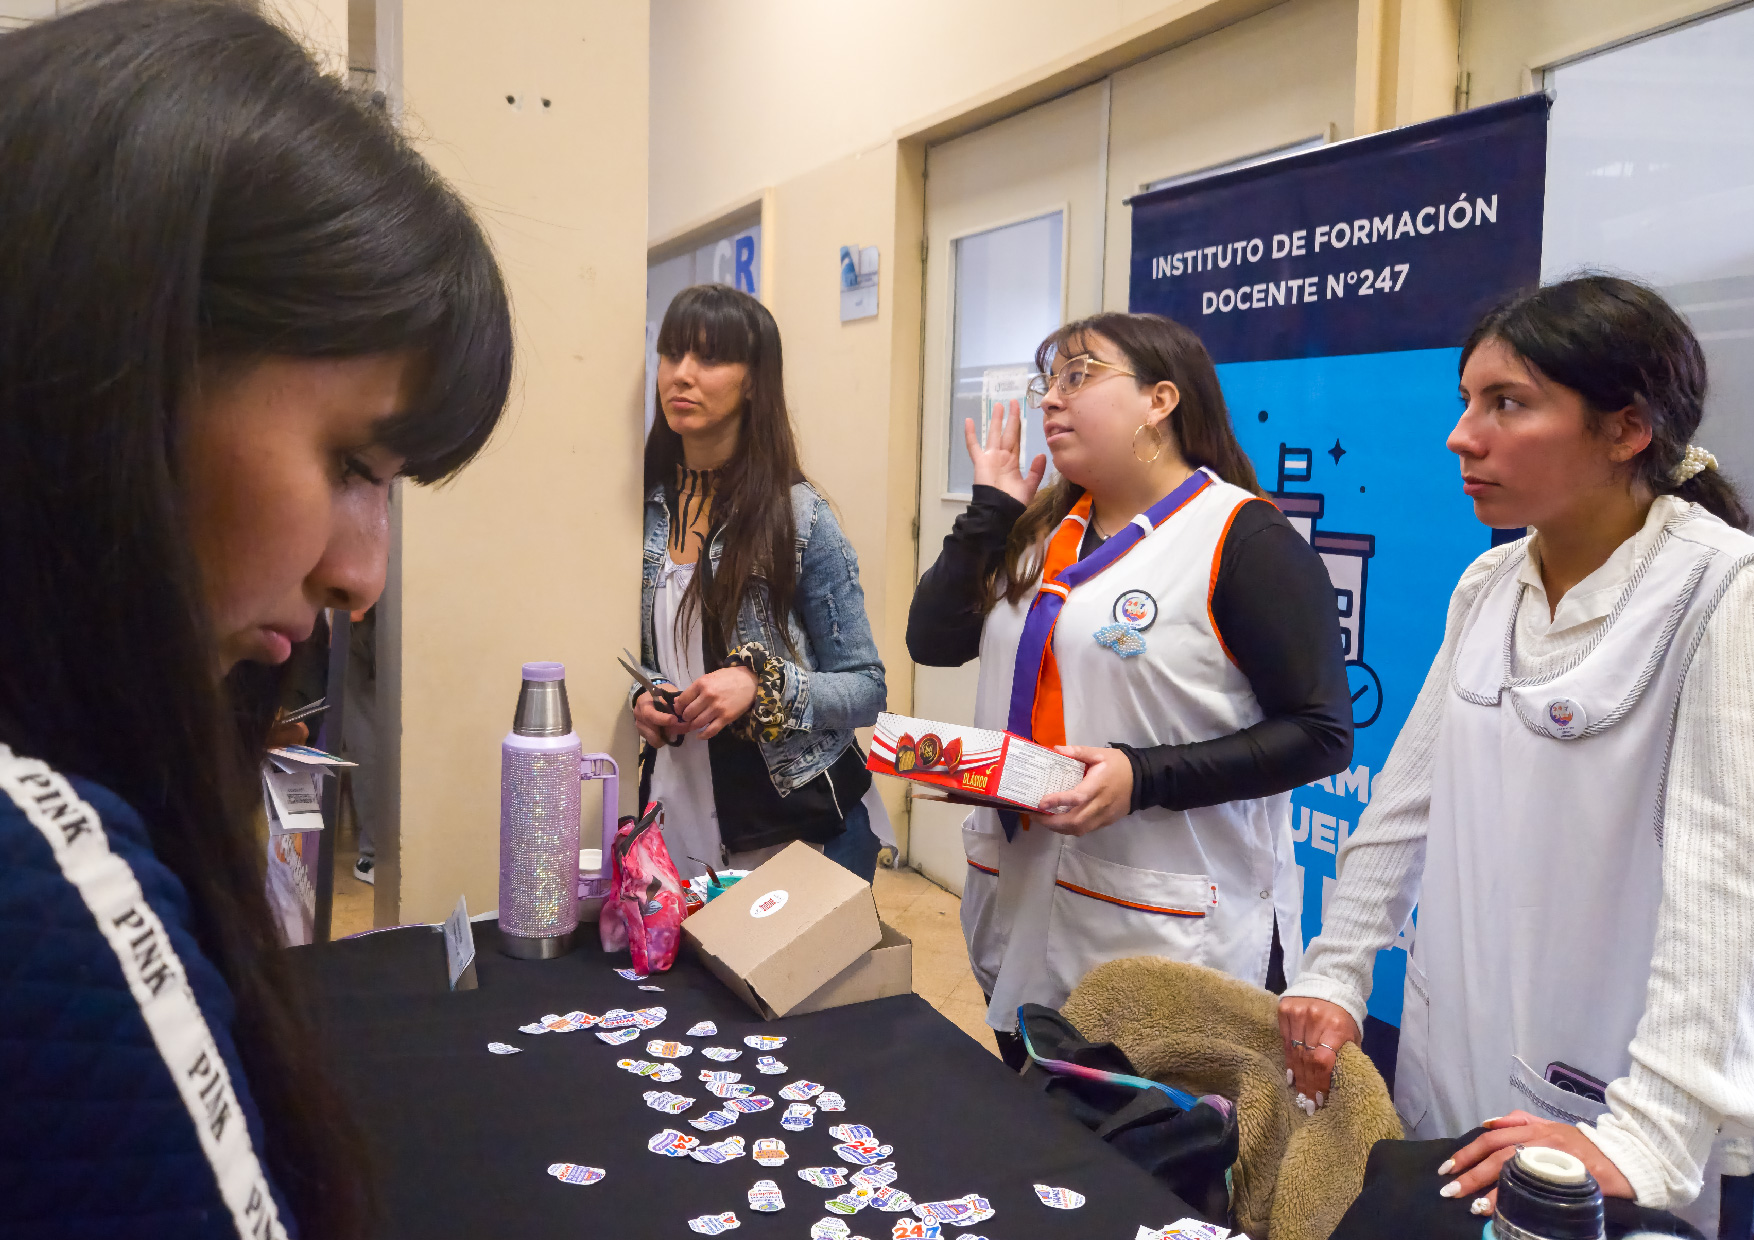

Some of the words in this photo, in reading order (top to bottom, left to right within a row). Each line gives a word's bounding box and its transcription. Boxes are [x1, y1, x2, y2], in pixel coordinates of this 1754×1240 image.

[1152, 238, 1263, 280] INSTITUTO
[1272, 229, 1306, 260] DE
[1314, 193, 1498, 253] FORMACIÓN
[1202, 275, 1319, 315] DOCENTE
[19, 771, 92, 845] PINK
[113, 908, 176, 996] PINK
[188, 1053, 232, 1142] PINK
